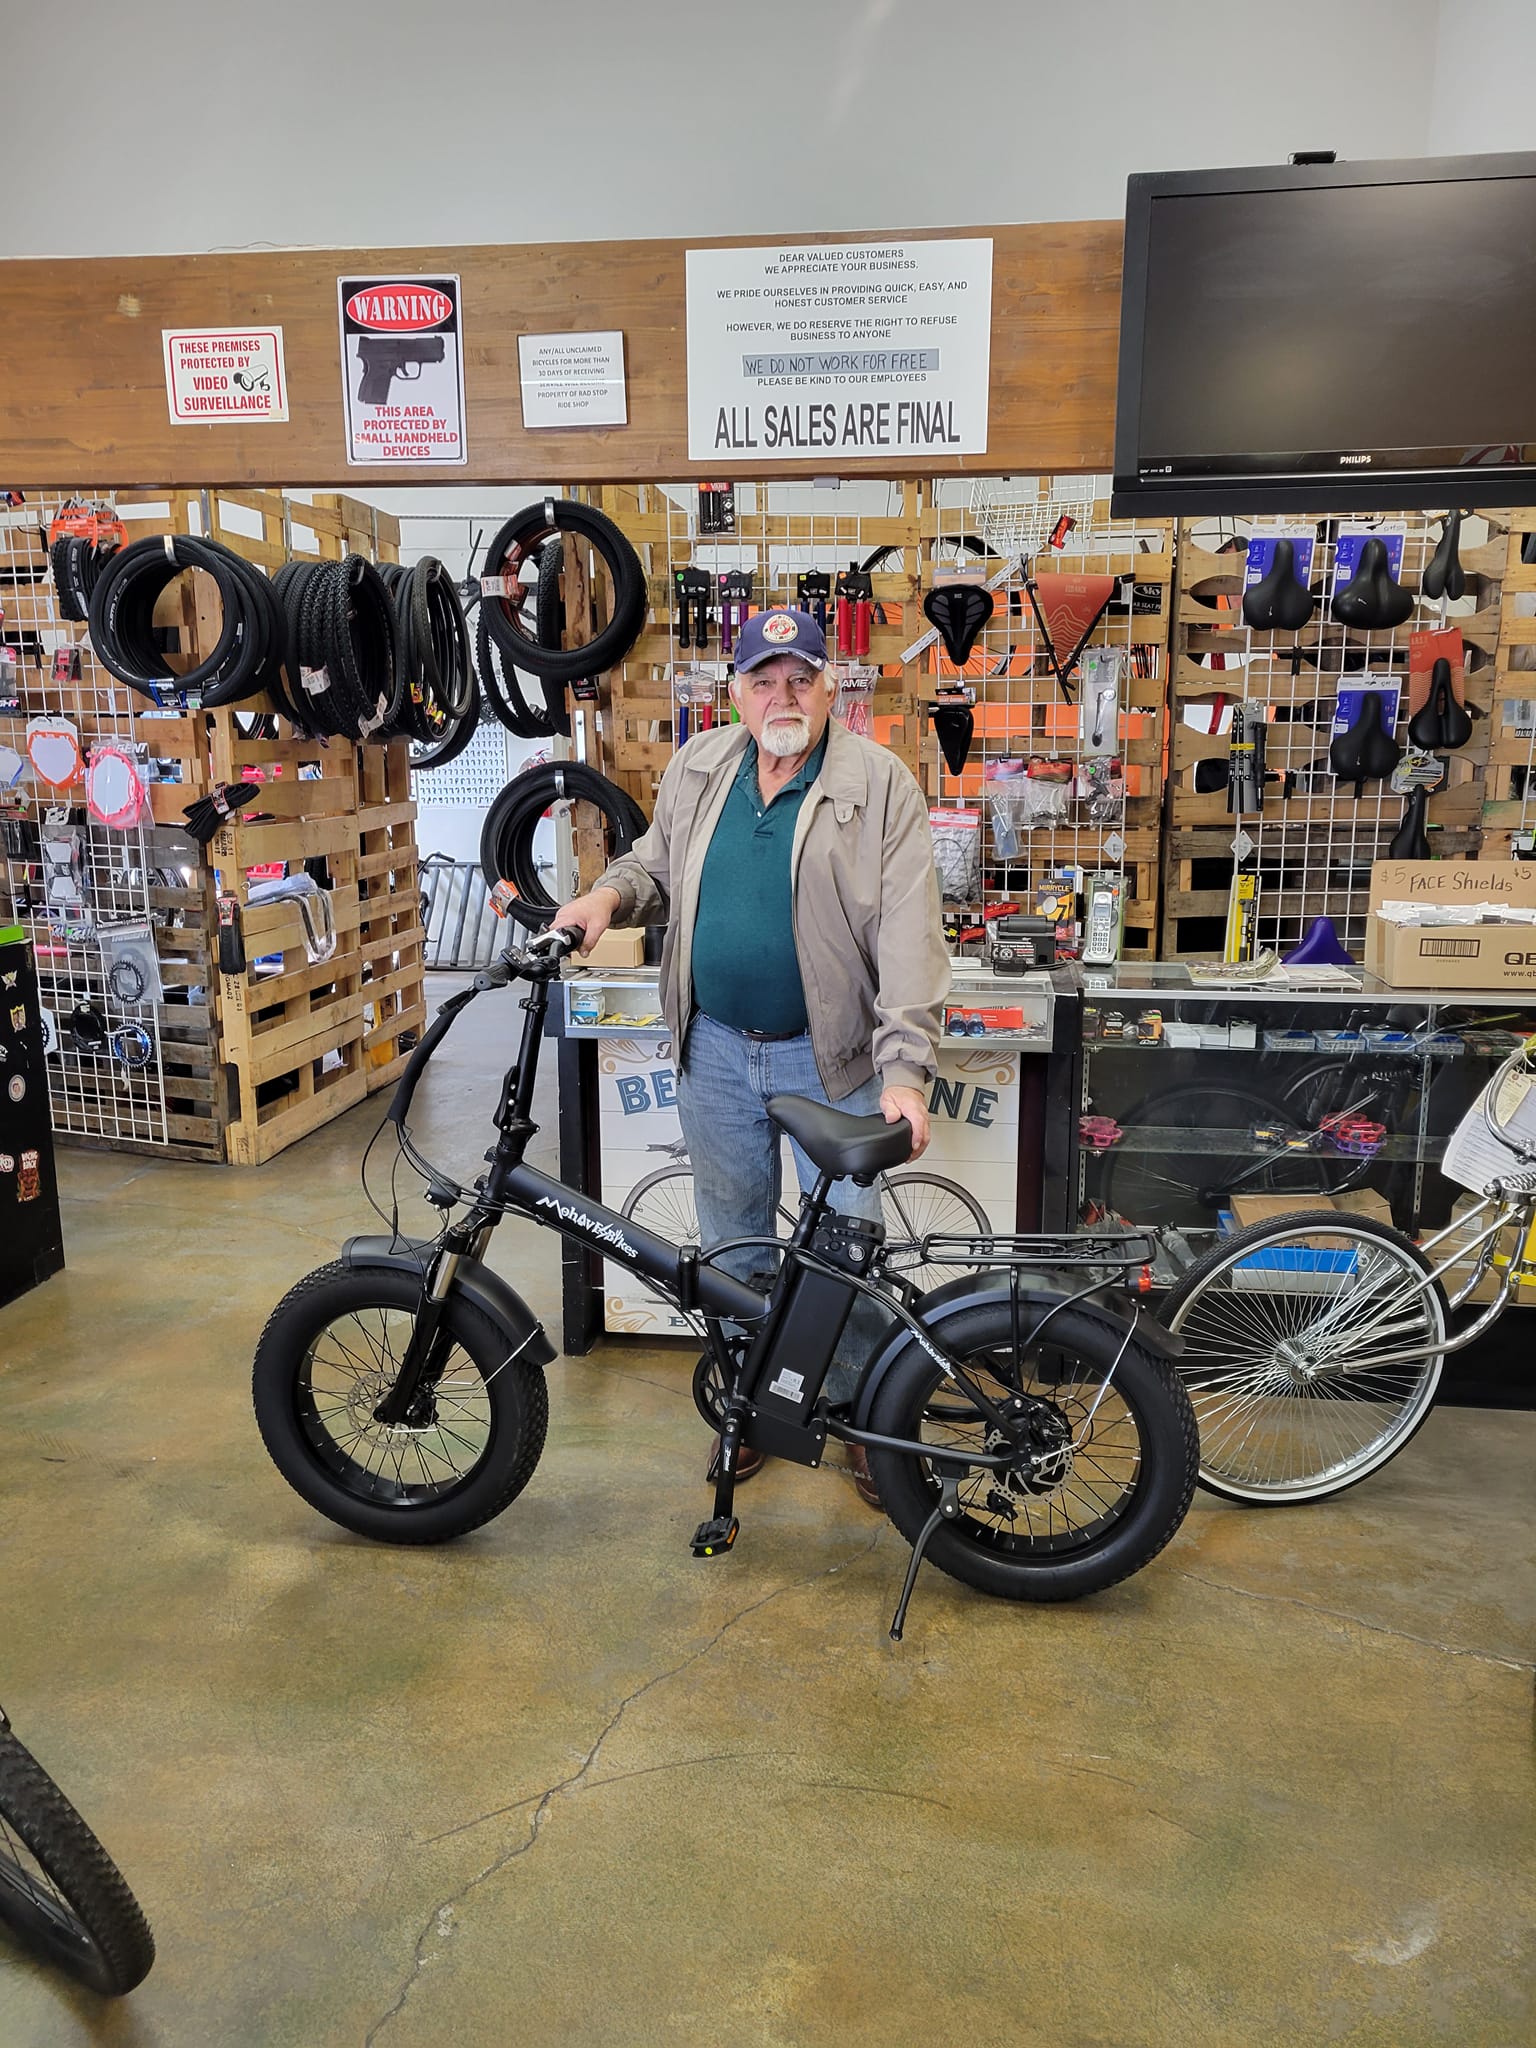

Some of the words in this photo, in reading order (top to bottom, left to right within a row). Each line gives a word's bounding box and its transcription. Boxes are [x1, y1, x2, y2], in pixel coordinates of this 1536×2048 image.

[780, 254, 804, 262] DEAR
[807, 252, 843, 261] VALUED
[846, 250, 904, 260] CUSTOMERS
[765, 266, 779, 274] WE
[781, 264, 838, 273] APPRECIATE
[841, 262, 867, 271] YOUR
[717, 290, 731, 298] WE
[734, 289, 761, 298] PRIDE
[763, 287, 817, 297] OURSELVES
[832, 284, 882, 294] PROVIDING
[884, 283, 916, 293] QUICK,
[919, 282, 945, 292] EASY,
[948, 281, 968, 290] AND
[775, 299, 812, 307] HONEST
[814, 297, 865, 306] CUSTOMER
[868, 295, 908, 304] SERVICE
[354, 295, 445, 321] WARNING
[726, 323, 774, 332] HOWEVER,
[777, 322, 791, 330] WE
[794, 321, 807, 329] DO
[809, 320, 852, 329] RESERVE
[855, 319, 872, 328] THE
[875, 318, 903, 327] RIGHT
[906, 317, 918, 326] TO
[920, 316, 958, 325] REFUSE
[791, 332, 836, 340] BUSINESS
[838, 331, 850, 339] TO
[853, 330, 891, 339] ANYONE
[179, 342, 209, 353] THESE
[212, 340, 260, 352] PREMISES
[539, 347, 565, 355] ANY/ALL
[566, 346, 602, 354] UNCLAIMED
[180, 357, 234, 369] PROTECTED
[238, 356, 250, 367] BY
[746, 360, 763, 374] WE
[770, 358, 784, 374] DO
[790, 357, 814, 372] NOT
[818, 355, 859, 370] WORK
[863, 354, 887, 369] FOR
[891, 353, 927, 369] FREE
[193, 376, 228, 390] VIDEO
[757, 377, 792, 386] PLEASE
[795, 376, 807, 385] BE
[810, 375, 832, 384] KIND
[834, 375, 846, 384] TO
[848, 374, 868, 383] OUR
[871, 373, 926, 383] EMPLOYEES
[184, 395, 271, 411] SURVEILLANCE
[375, 407, 401, 416] THIS
[404, 406, 434, 416] AREA
[364, 420, 430, 430] PROTECTED
[433, 419, 446, 429] BY
[714, 406, 758, 448] ALL
[764, 404, 836, 447] SALES
[842, 403, 890, 446] ARE
[897, 401, 960, 444] FINAL
[355, 433, 390, 444] SMALL
[395, 432, 458, 443] HANDHELD
[383, 446, 430, 456] DEVICES
[1340, 456, 1372, 464] PHILIPS
[1410, 872, 1447, 893] FACE
[1452, 872, 1513, 892] Shields
